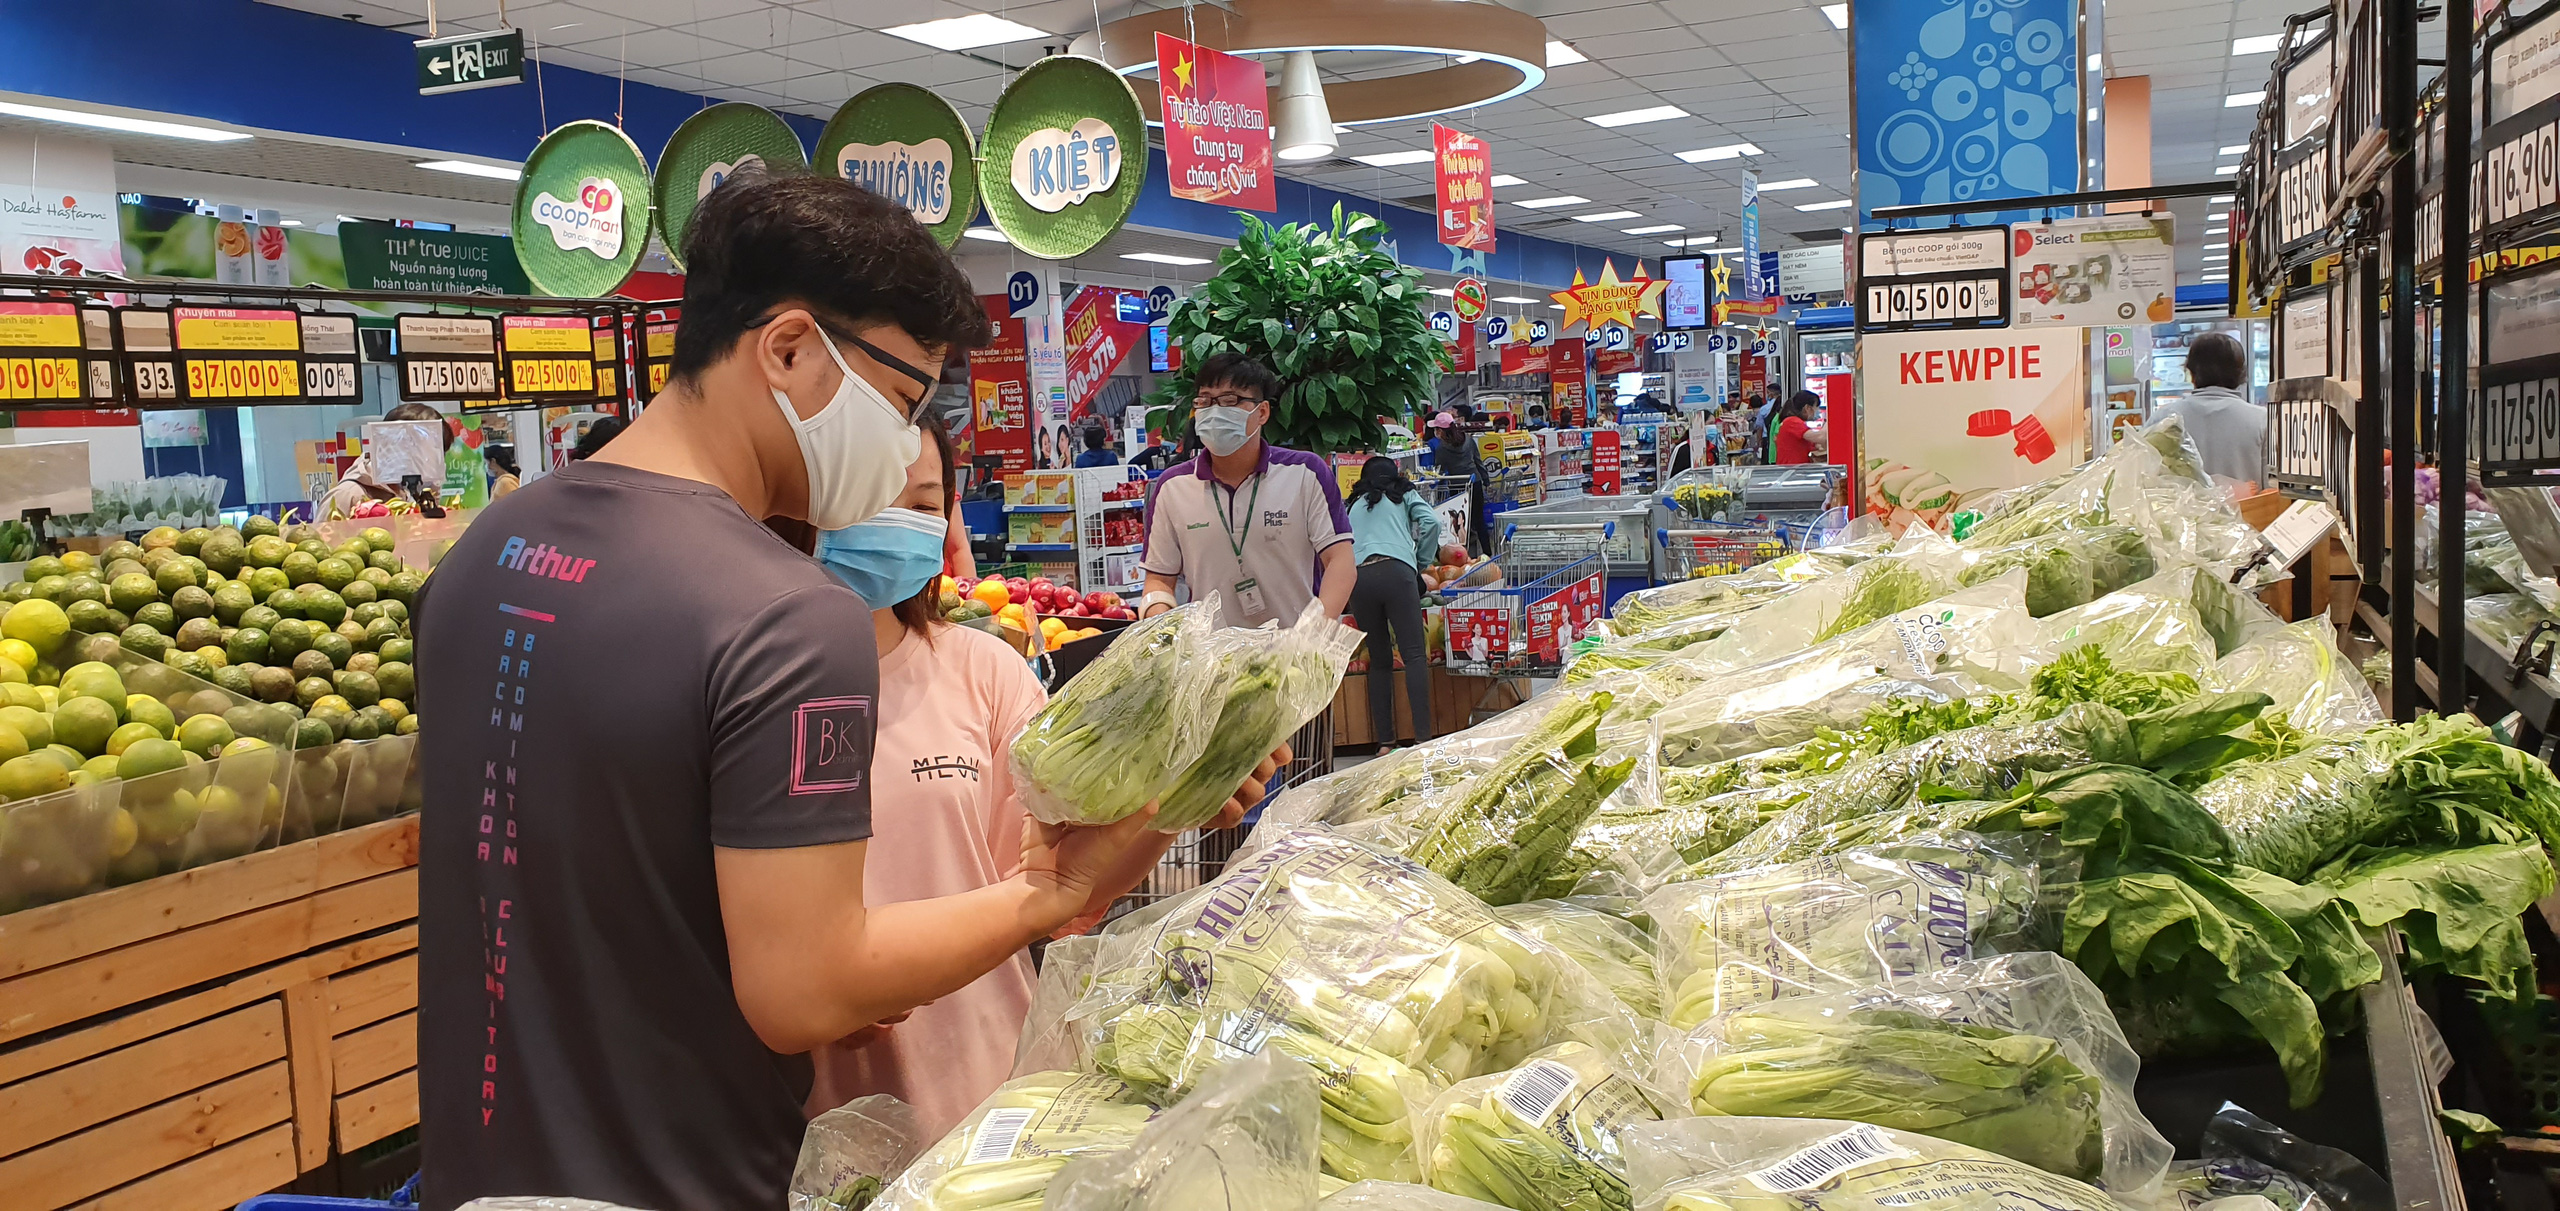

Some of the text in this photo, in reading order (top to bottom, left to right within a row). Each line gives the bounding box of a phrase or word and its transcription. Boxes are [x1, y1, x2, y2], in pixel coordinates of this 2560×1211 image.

[485, 47, 509, 69] EXIT
[1209, 98, 1236, 132] Việt
[1236, 104, 1264, 130] Nam
[1193, 135, 1244, 163] Chung tay
[1029, 131, 1116, 203] KIỆT
[1187, 162, 1218, 191] chống
[844, 149, 946, 214] THƯỜNG
[3, 198, 107, 221] Dalat Hasfarm
[589, 218, 619, 235] mart
[1918, 244, 1943, 253] COOP
[1946, 242, 1960, 253] gói
[1961, 241, 1983, 250] 300g
[2035, 233, 2074, 246] Select
[385, 239, 489, 262] TH true JUICE
[1956, 253, 1980, 261] VietGAP
[458, 265, 488, 281] lượng
[1010, 279, 1034, 302] 01
[1580, 283, 1637, 302] TIN DÙNG
[1875, 286, 1972, 313] 10.500
[1149, 294, 1171, 313] 02
[1578, 298, 1641, 315] HÀNG VIỆT
[39, 316, 44, 325] 2
[1431, 318, 1450, 330] 06
[1488, 321, 1504, 335] 07
[1530, 324, 1546, 338] 08
[1585, 328, 1600, 342] 09
[1606, 331, 1622, 343] 10
[1655, 335, 1668, 346] 11
[1674, 335, 1687, 346] 12
[1709, 337, 1722, 347] 13
[2109, 348, 2131, 356] mart
[1900, 345, 2041, 385] KEWPIE
[191, 364, 279, 389] 37.000
[412, 366, 479, 387] 17.500
[516, 364, 578, 386] 22.500
[1264, 509, 1289, 519] Pedia
[1264, 518, 1283, 527] Plus
[497, 535, 598, 584] Arthur
[1541, 601, 1558, 612] SHIN
[490, 628, 516, 727] BACH
[502, 633, 536, 866] BADMINTON
[818, 717, 856, 767] BK
[911, 755, 980, 783] MEOW
[477, 759, 498, 862] KHOA
[1873, 1193, 1907, 1207] Minh
[1907, 1189, 1931, 1203] Chí
